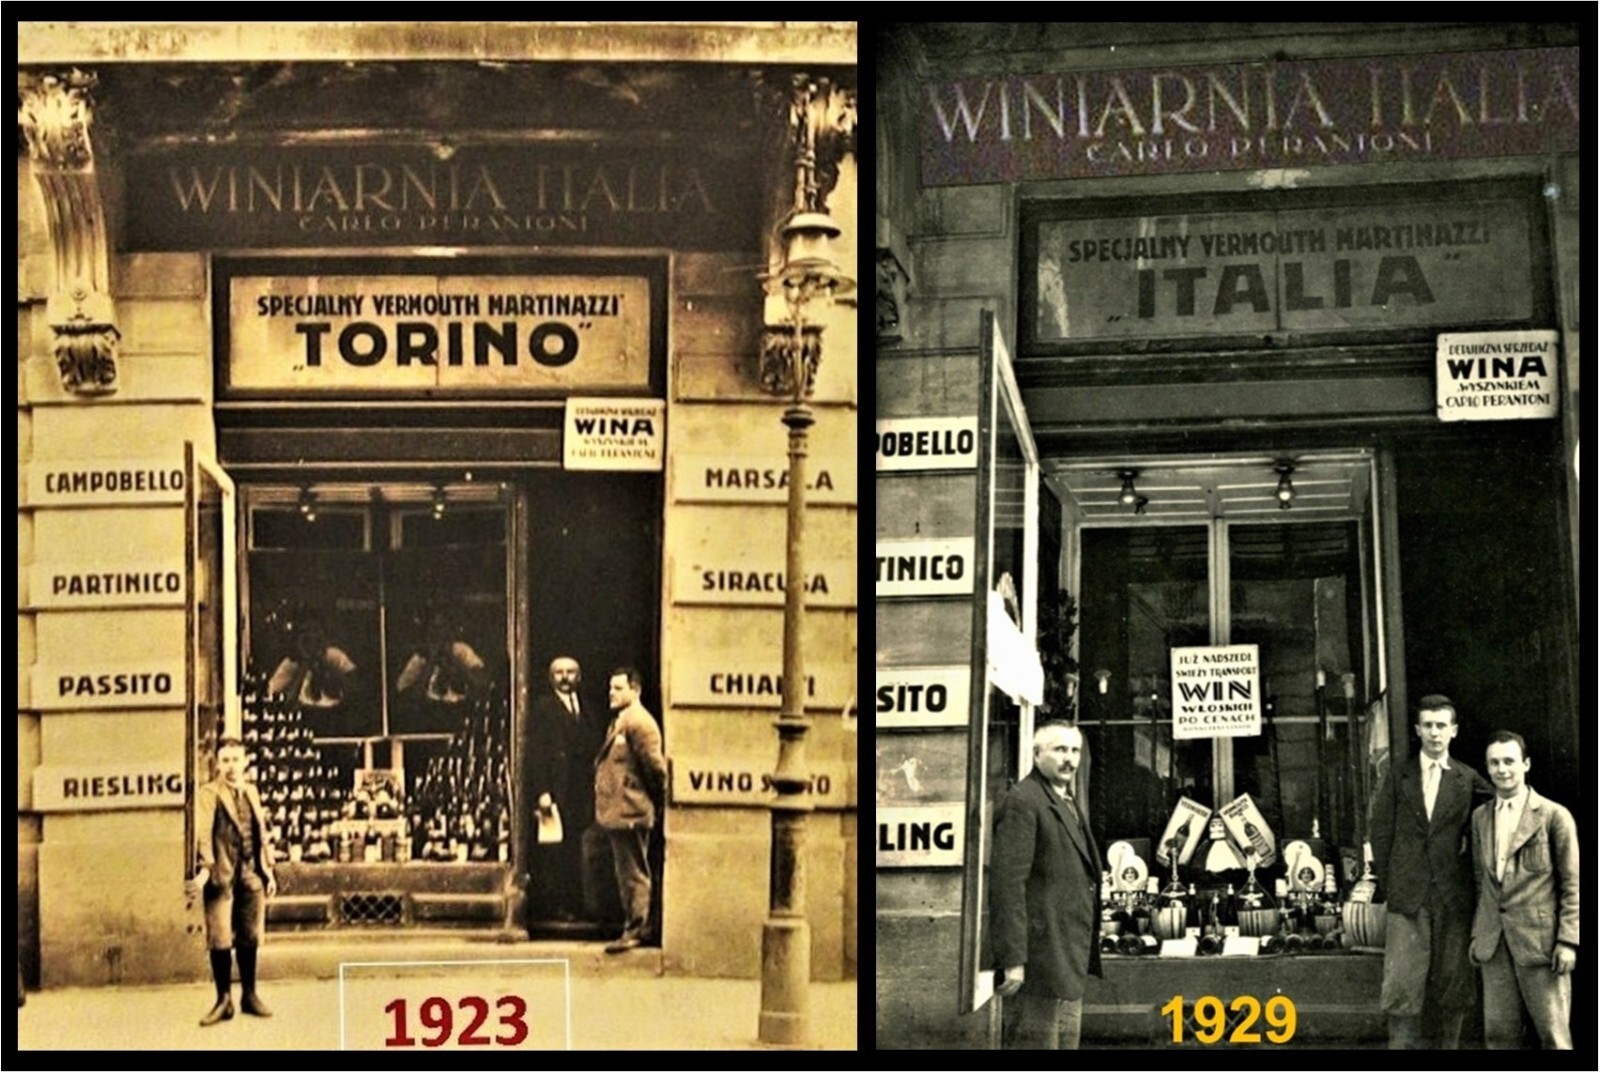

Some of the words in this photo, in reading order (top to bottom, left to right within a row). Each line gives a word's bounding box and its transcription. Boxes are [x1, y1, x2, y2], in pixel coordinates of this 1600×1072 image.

[927, 62, 1333, 142] WINIARNIA
[168, 164, 507, 214] WINIARNIA
[1068, 234, 1191, 263] SPECJALNY
[1201, 228, 1326, 257] VERMOUTH
[1335, 220, 1491, 251] MARTINAZZI
[257, 295, 364, 317] SPECJALNY
[372, 294, 480, 317] VERMOUTH
[1446, 356, 1547, 379] WINA
[1482, 393, 1550, 406] PERANTONI
[575, 418, 654, 436] WINA
[876, 428, 974, 458] OBELLO
[45, 470, 184, 493] CAMPOBELLO
[705, 467, 835, 491] MARSAA
[52, 571, 181, 595] PARTINICO
[58, 673, 172, 697] PASSITO
[710, 672, 815, 697] CHIAI
[1178, 680, 1252, 702] WIN
[63, 773, 184, 799] RIESLING
[689, 770, 753, 793] VINO
